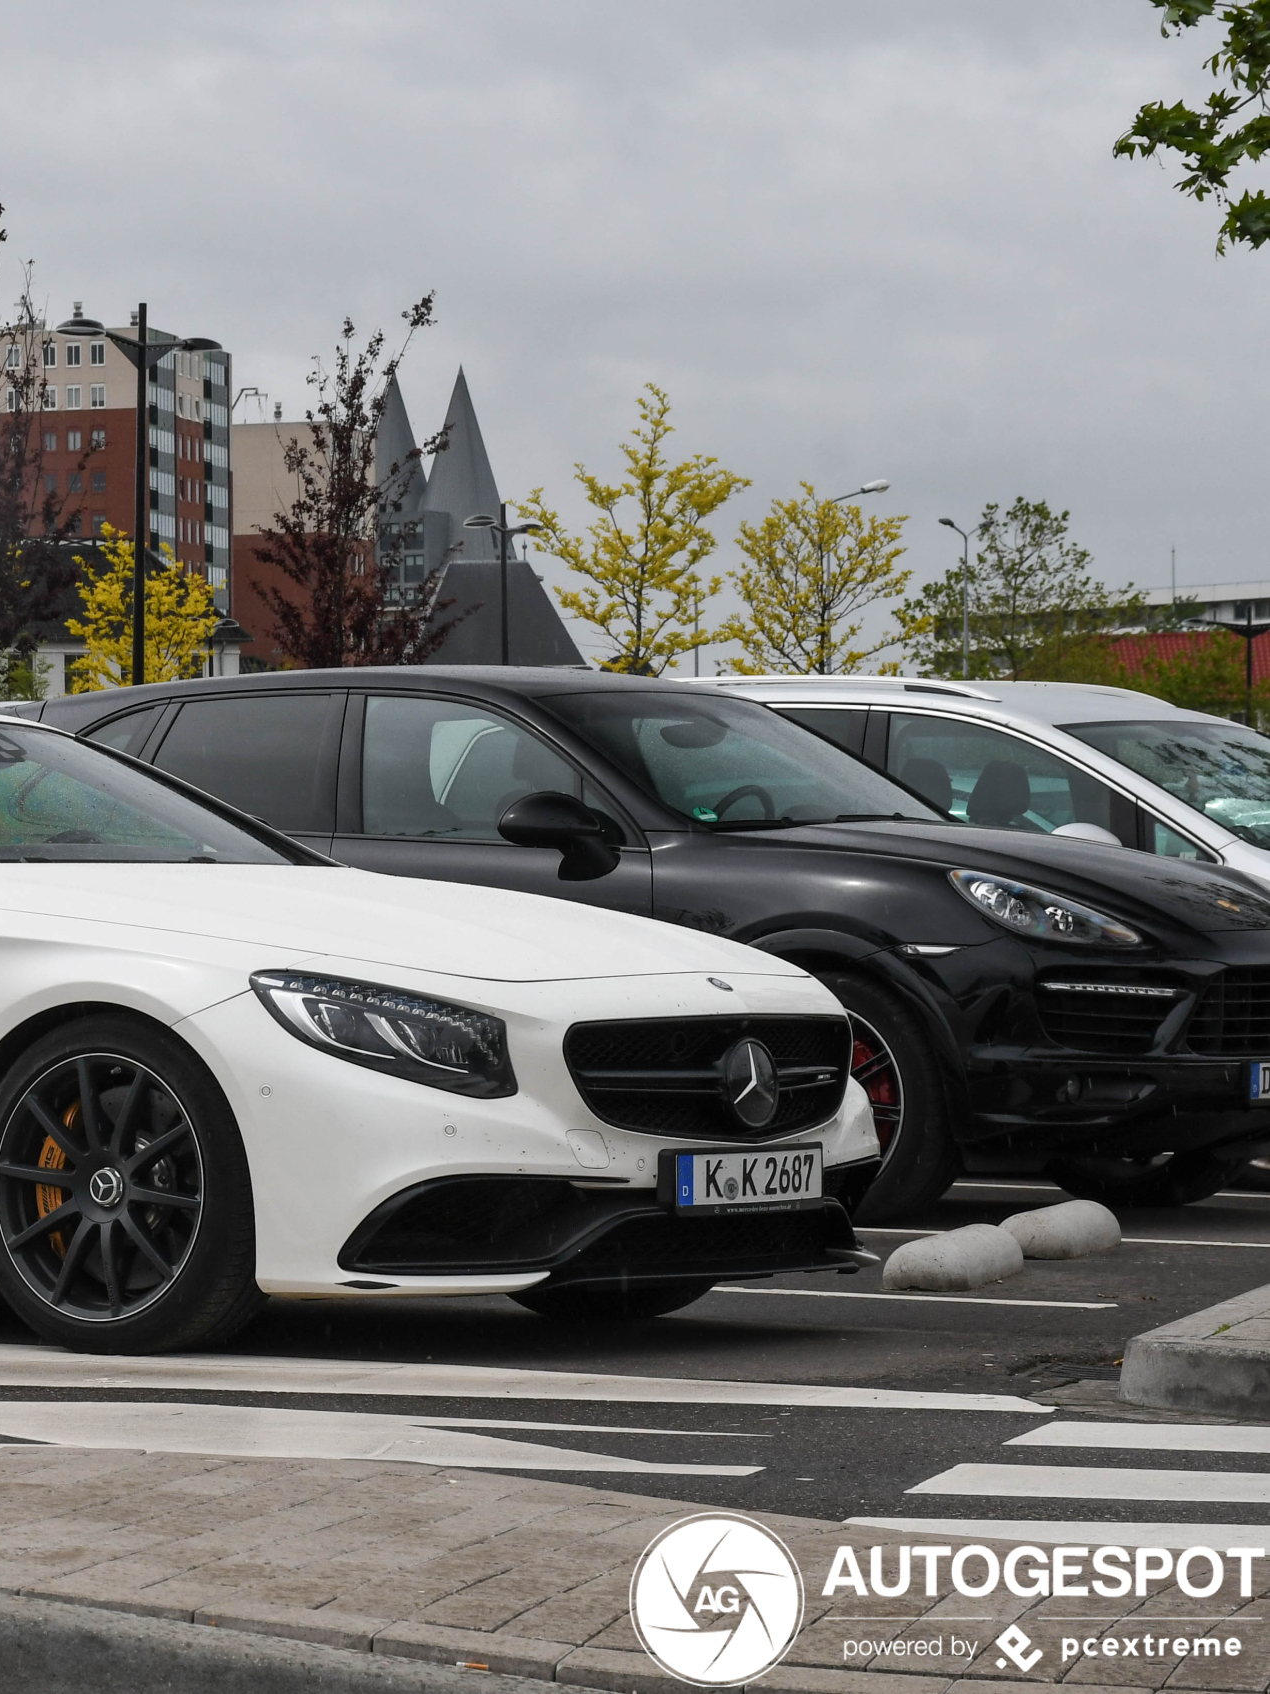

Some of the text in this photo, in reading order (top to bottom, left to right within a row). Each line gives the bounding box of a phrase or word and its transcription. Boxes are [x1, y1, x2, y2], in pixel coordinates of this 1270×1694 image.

[705, 1154, 814, 1198] K K 2687
[682, 1185, 689, 1196] D
